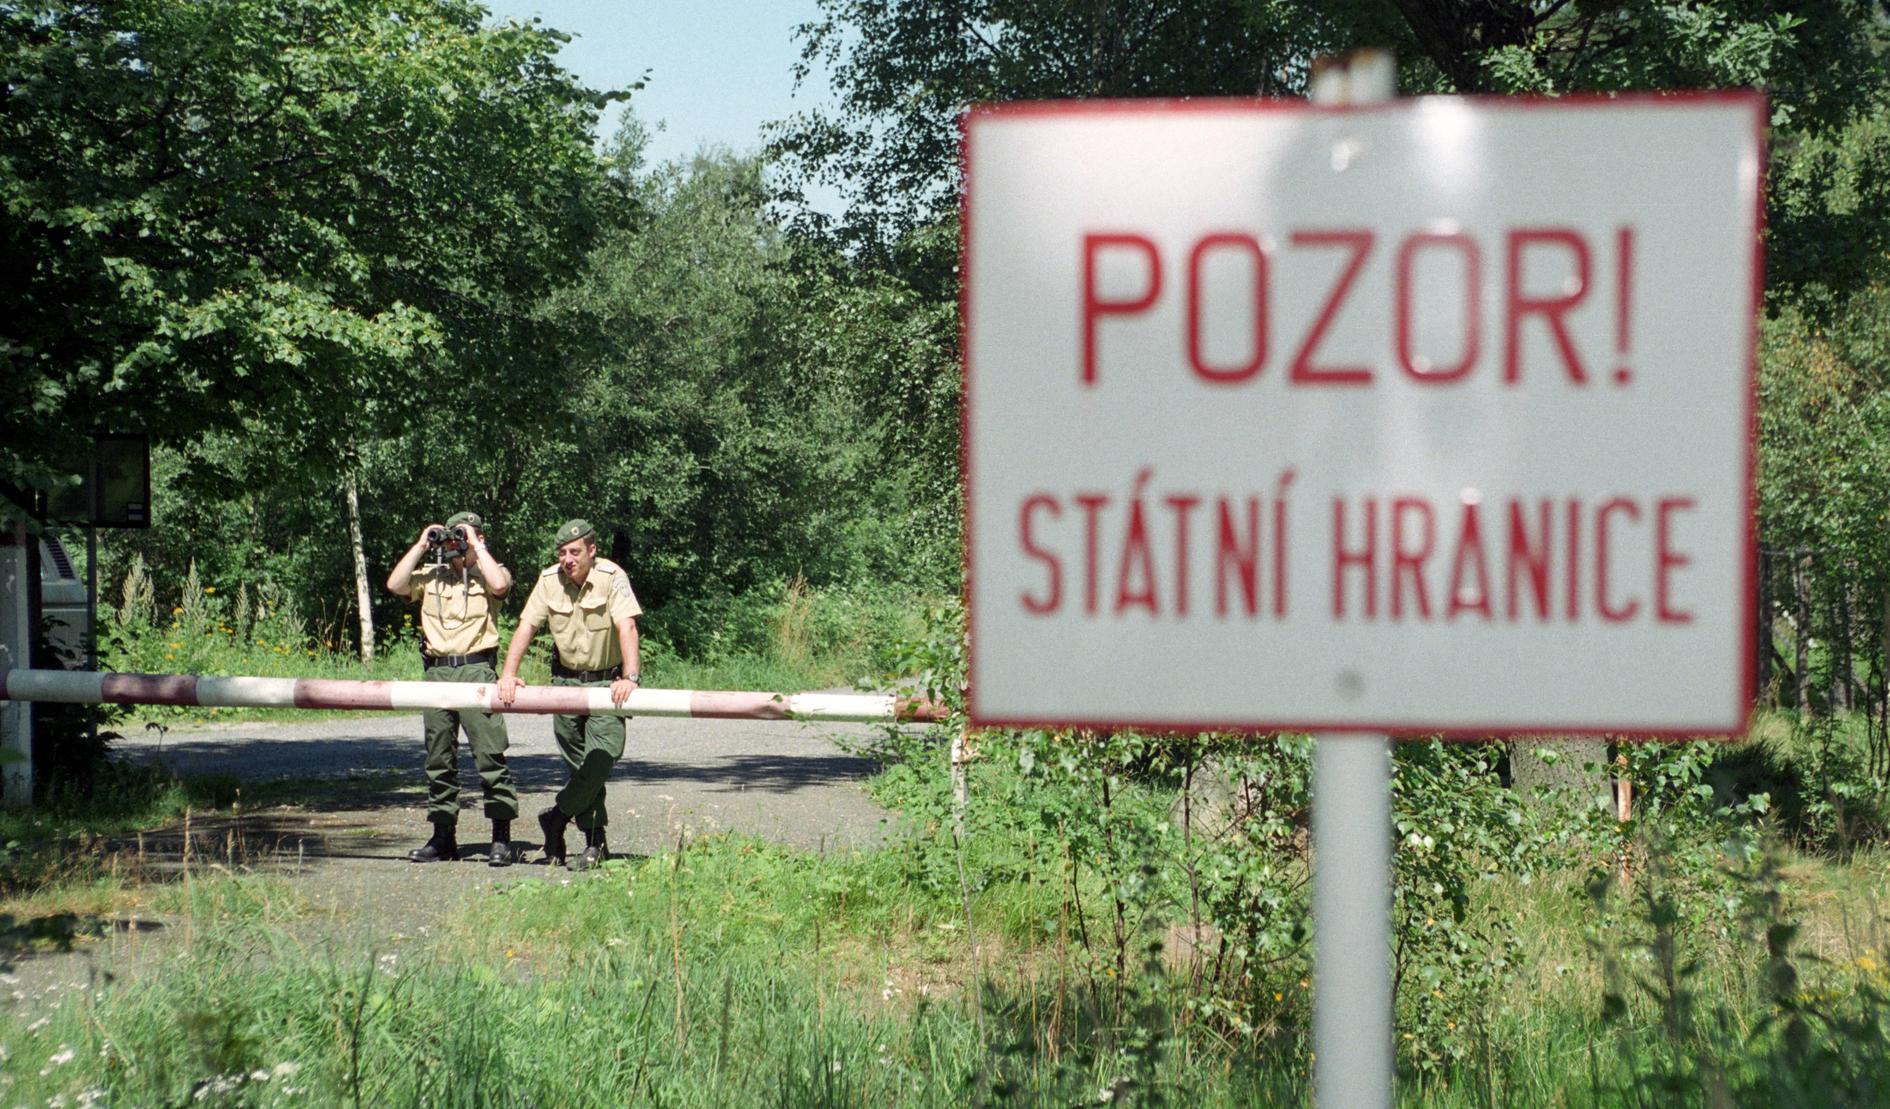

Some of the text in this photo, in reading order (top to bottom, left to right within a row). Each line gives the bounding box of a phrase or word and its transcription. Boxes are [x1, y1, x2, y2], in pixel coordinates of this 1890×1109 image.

[1079, 227, 1636, 387] POZOR!
[1018, 467, 1696, 625] STÁTNÍ HRANICE
